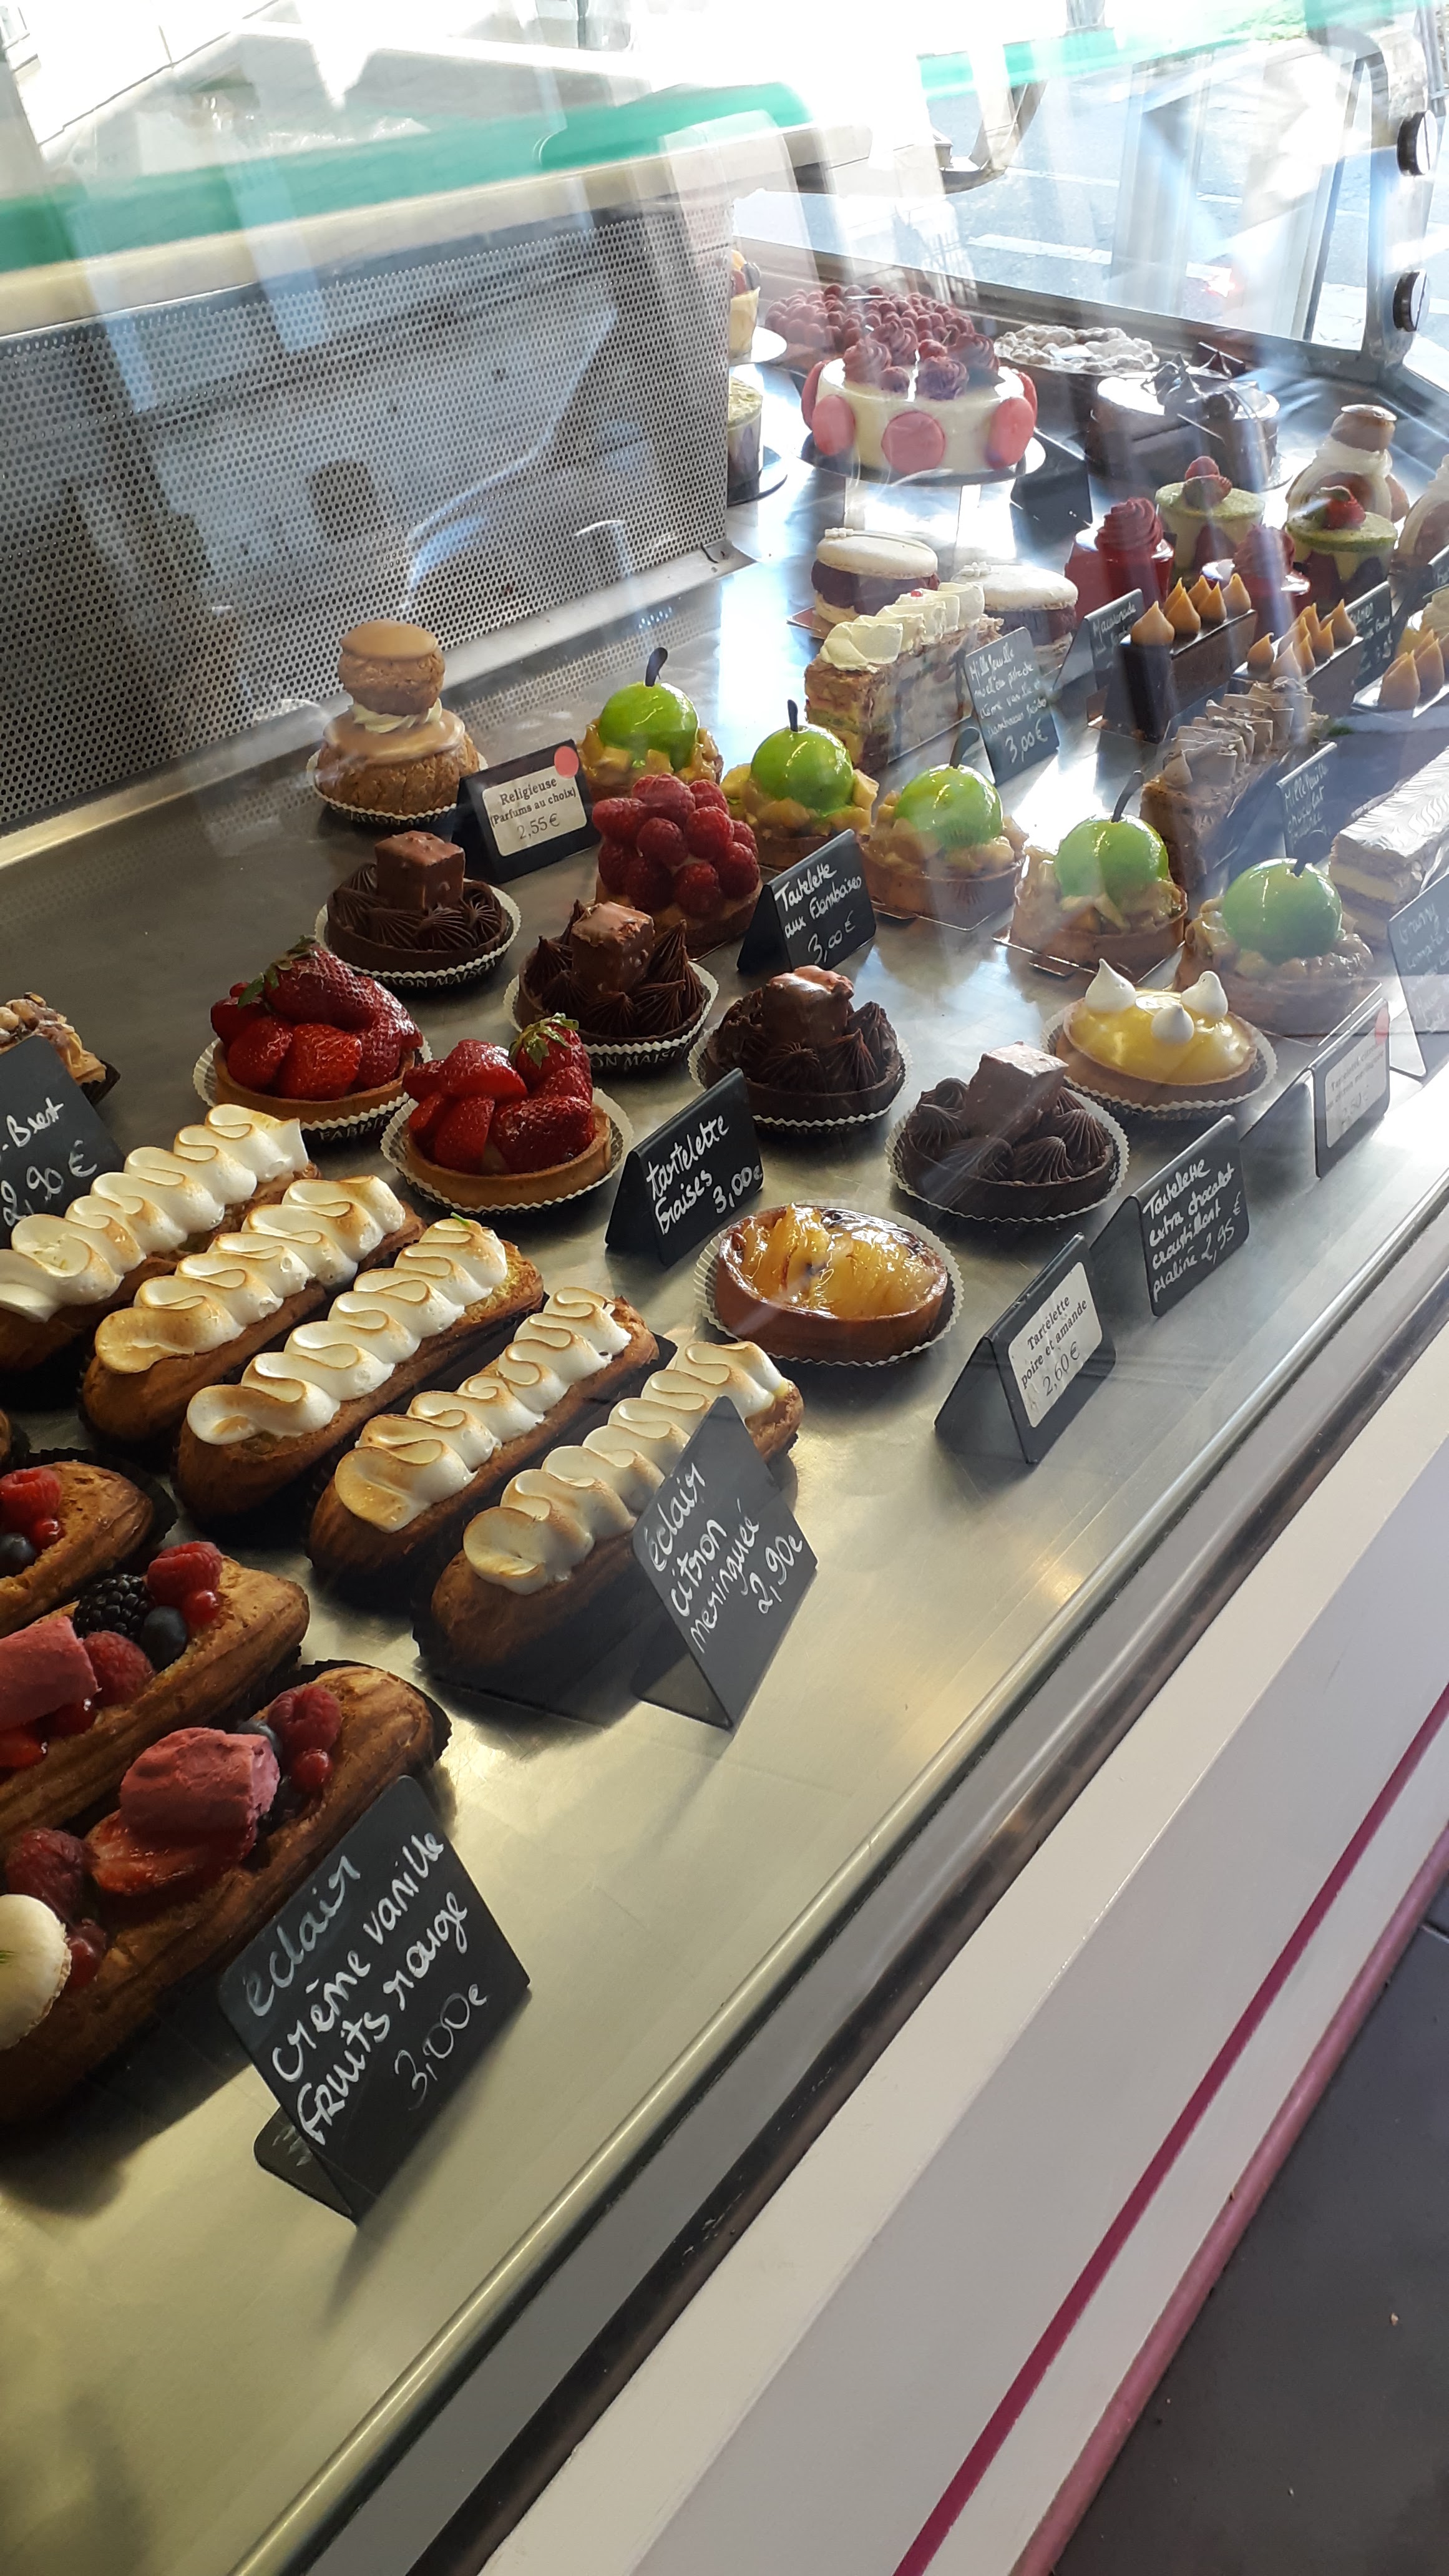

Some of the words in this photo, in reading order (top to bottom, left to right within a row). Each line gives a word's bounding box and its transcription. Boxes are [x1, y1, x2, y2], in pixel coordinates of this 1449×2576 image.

[490, 804, 532, 827] (Parfums
[534, 798, 547, 810] au
[548, 787, 577, 805] choix)
[500, 778, 557, 806] Religieuse
[774, 863, 837, 912] Tartelette
[784, 916, 807, 939] aux
[646, 1115, 729, 1201] tartelette
[1142, 1159, 1211, 1219] Tartelette
[1149, 1211, 1184, 1247] extra
[1020, 1354, 1044, 1390] poire
[1045, 1340, 1055, 1357] et
[1055, 1299, 1088, 1344] amande
[1042, 1340, 1080, 1397] 2,60€
[671, 1519, 727, 1616] citron
[363, 1832, 444, 1945] vanille
